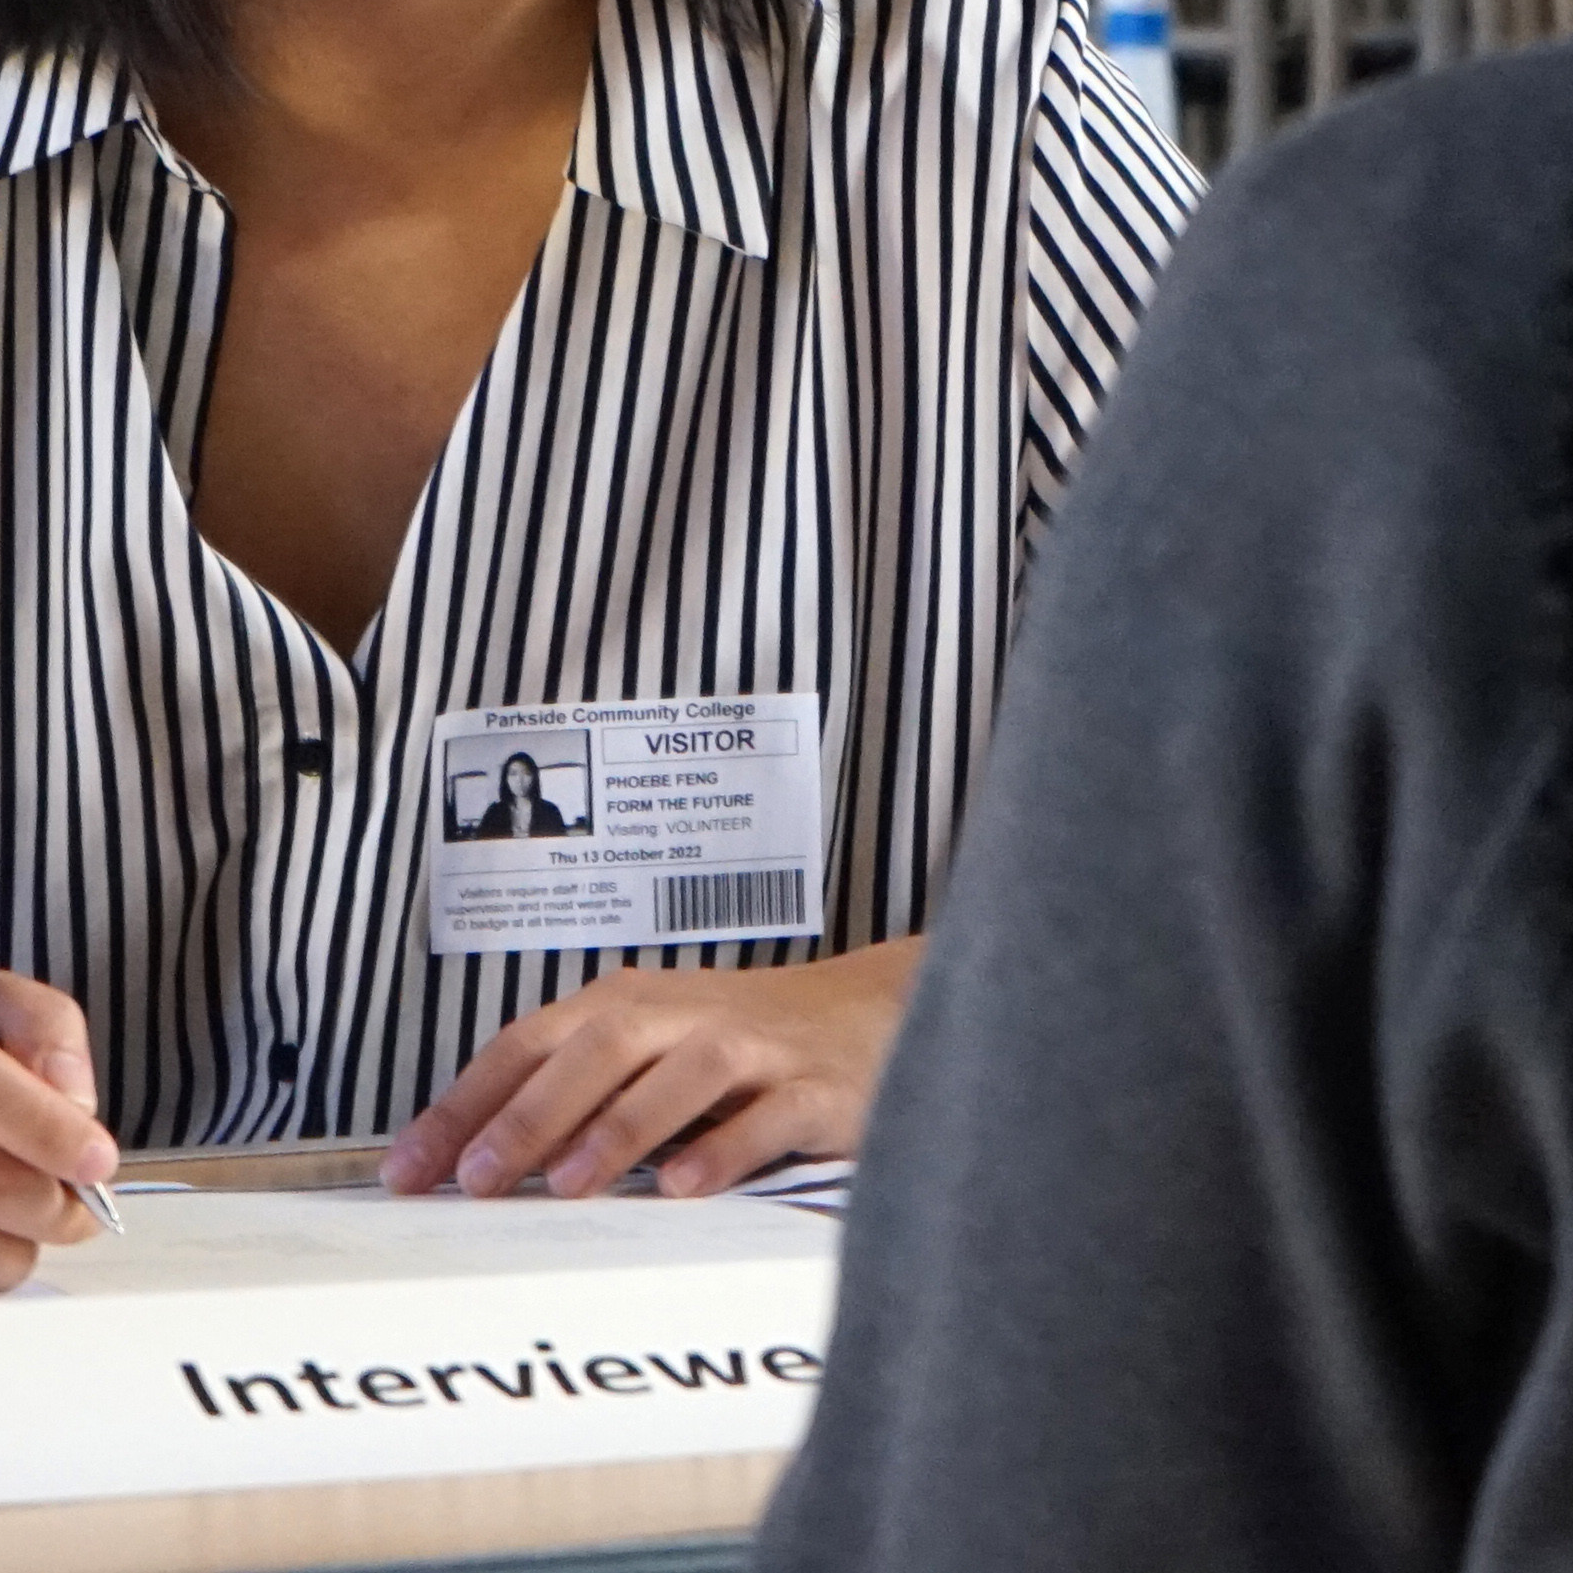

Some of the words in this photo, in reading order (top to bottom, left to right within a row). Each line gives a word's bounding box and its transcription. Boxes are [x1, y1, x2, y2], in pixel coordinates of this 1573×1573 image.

[486, 708, 567, 728] Parkside
[572, 704, 679, 724] Community
[686, 701, 756, 719] College
[644, 728, 756, 754] VISITOR
[605, 774, 671, 789] PHOEBE
[676, 771, 719, 786] FENG
[606, 800, 653, 813] FORM
[658, 797, 687, 811] THE
[692, 793, 754, 809] FUTURE
[666, 816, 753, 834] VOLUNTEER
[548, 851, 577, 865] Thu
[584, 850, 599, 863] 13
[603, 847, 663, 862] October
[668, 845, 703, 859] 2022
[589, 882, 618, 894] DBS
[180, 1339, 825, 1418] Interviewe
